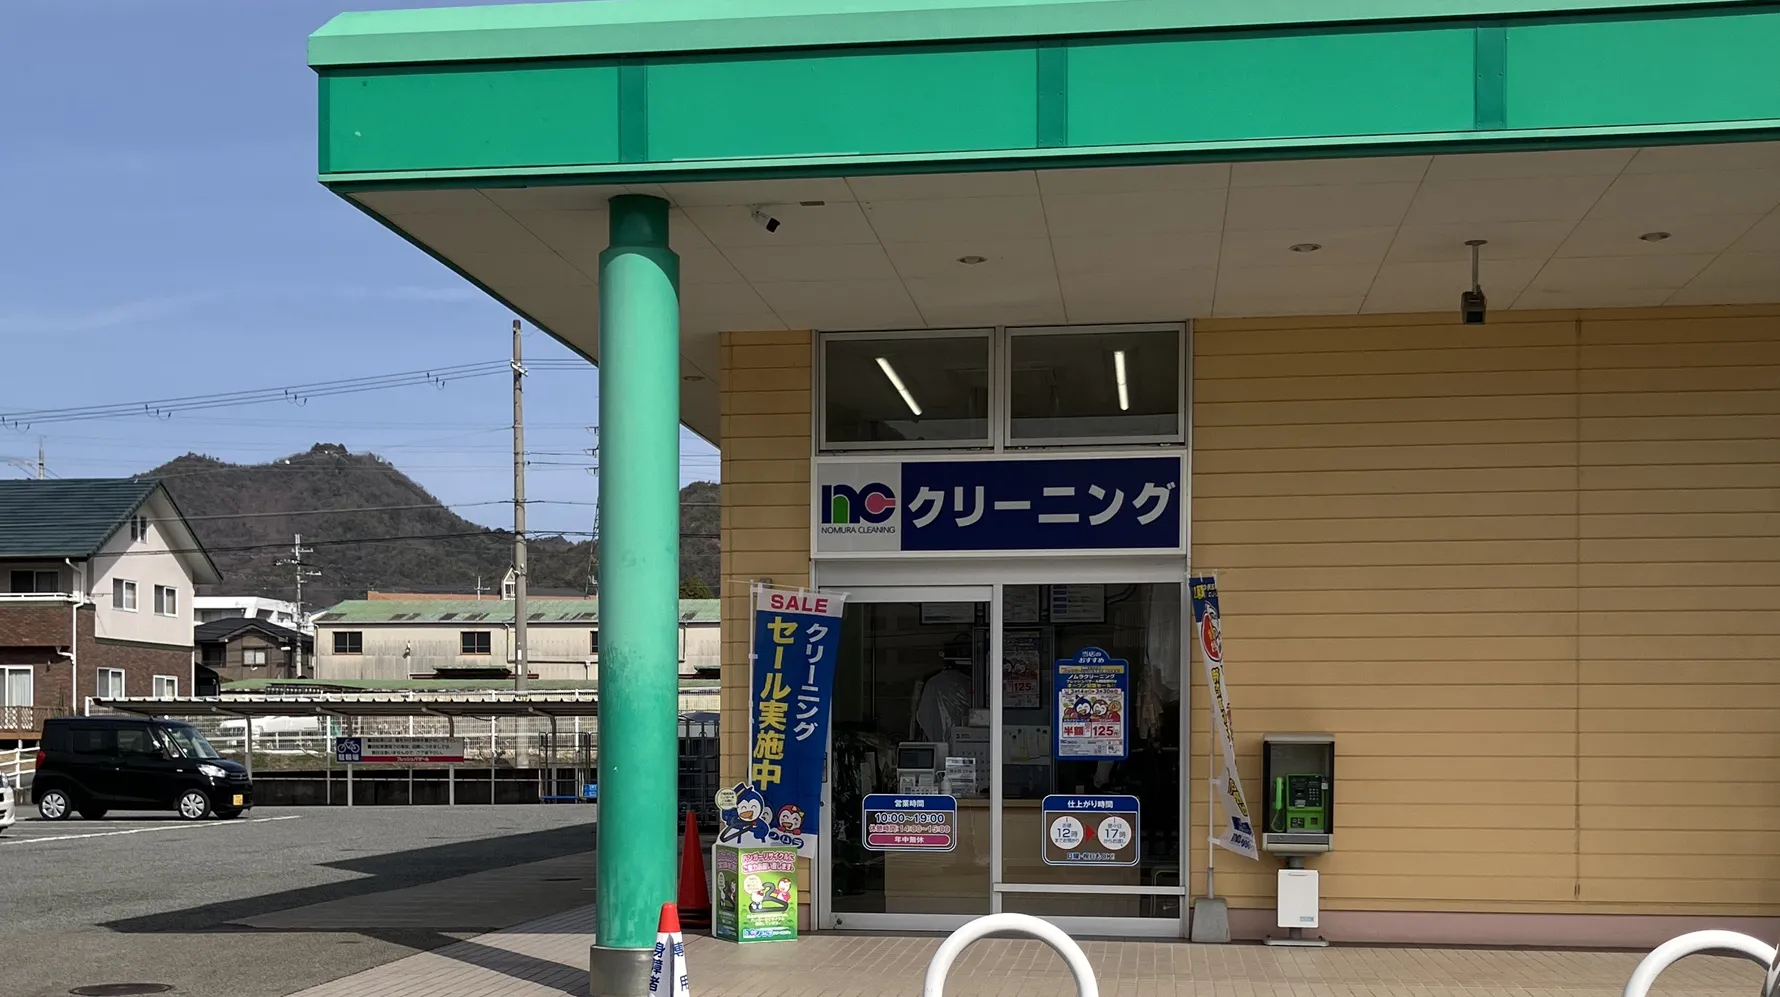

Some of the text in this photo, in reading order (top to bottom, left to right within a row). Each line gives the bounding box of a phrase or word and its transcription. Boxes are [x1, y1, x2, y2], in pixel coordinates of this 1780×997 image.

[908, 481, 1176, 529] クリーニング
[821, 525, 897, 535] NOMURA CLEANING
[770, 594, 829, 614] SALE
[792, 622, 829, 742] クリーニング
[752, 616, 799, 791] セール実施中
[1063, 726, 1084, 736] 半額
[894, 799, 925, 808] 営業時間
[1067, 800, 1114, 809] 仕上がり時間
[1056, 828, 1078, 838] 12時
[1104, 828, 1127, 839] 17時
[768, 830, 805, 850] ノムラ
[894, 836, 925, 844] 年中無休
[742, 851, 796, 862] ハンガーリサイクルに
[649, 941, 666, 992] 身障者
